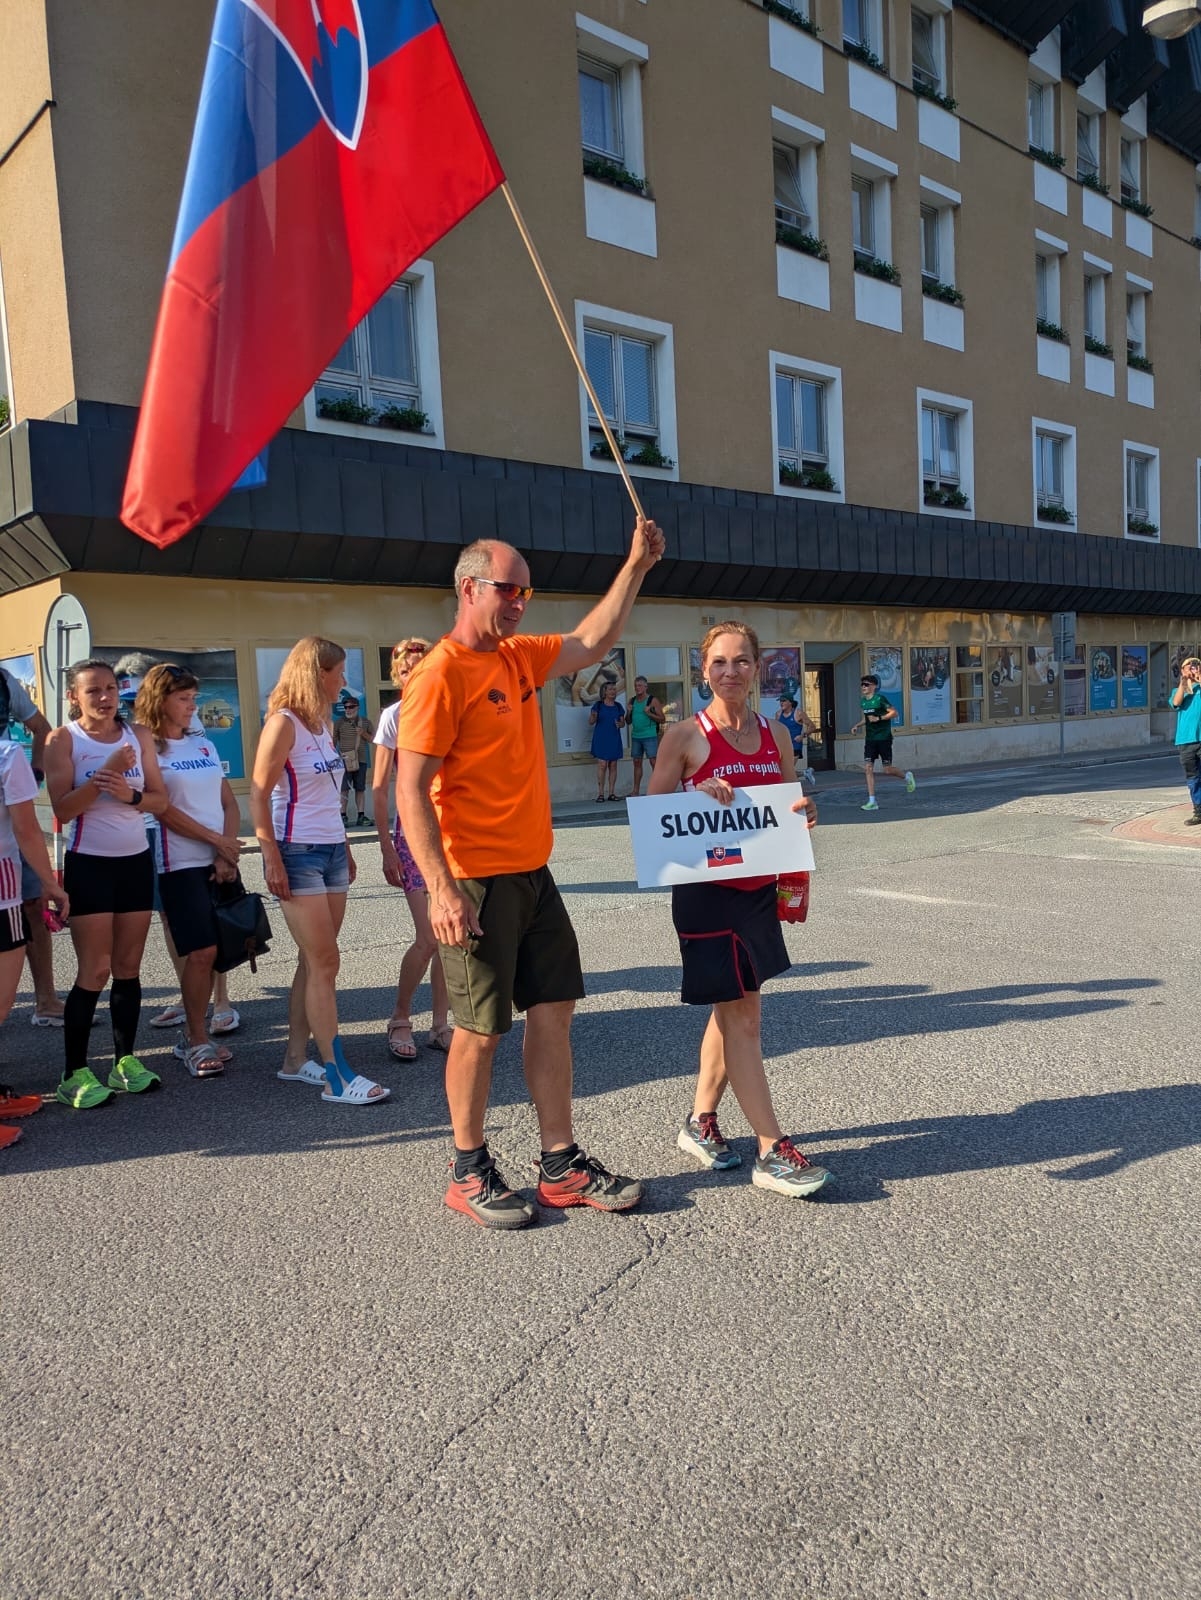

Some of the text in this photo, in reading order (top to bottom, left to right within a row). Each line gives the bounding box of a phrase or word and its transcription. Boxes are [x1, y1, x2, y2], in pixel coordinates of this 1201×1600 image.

[85, 767, 142, 779] SKIA
[713, 760, 782, 778] czech republ
[660, 805, 779, 839] SLOVAKIA
